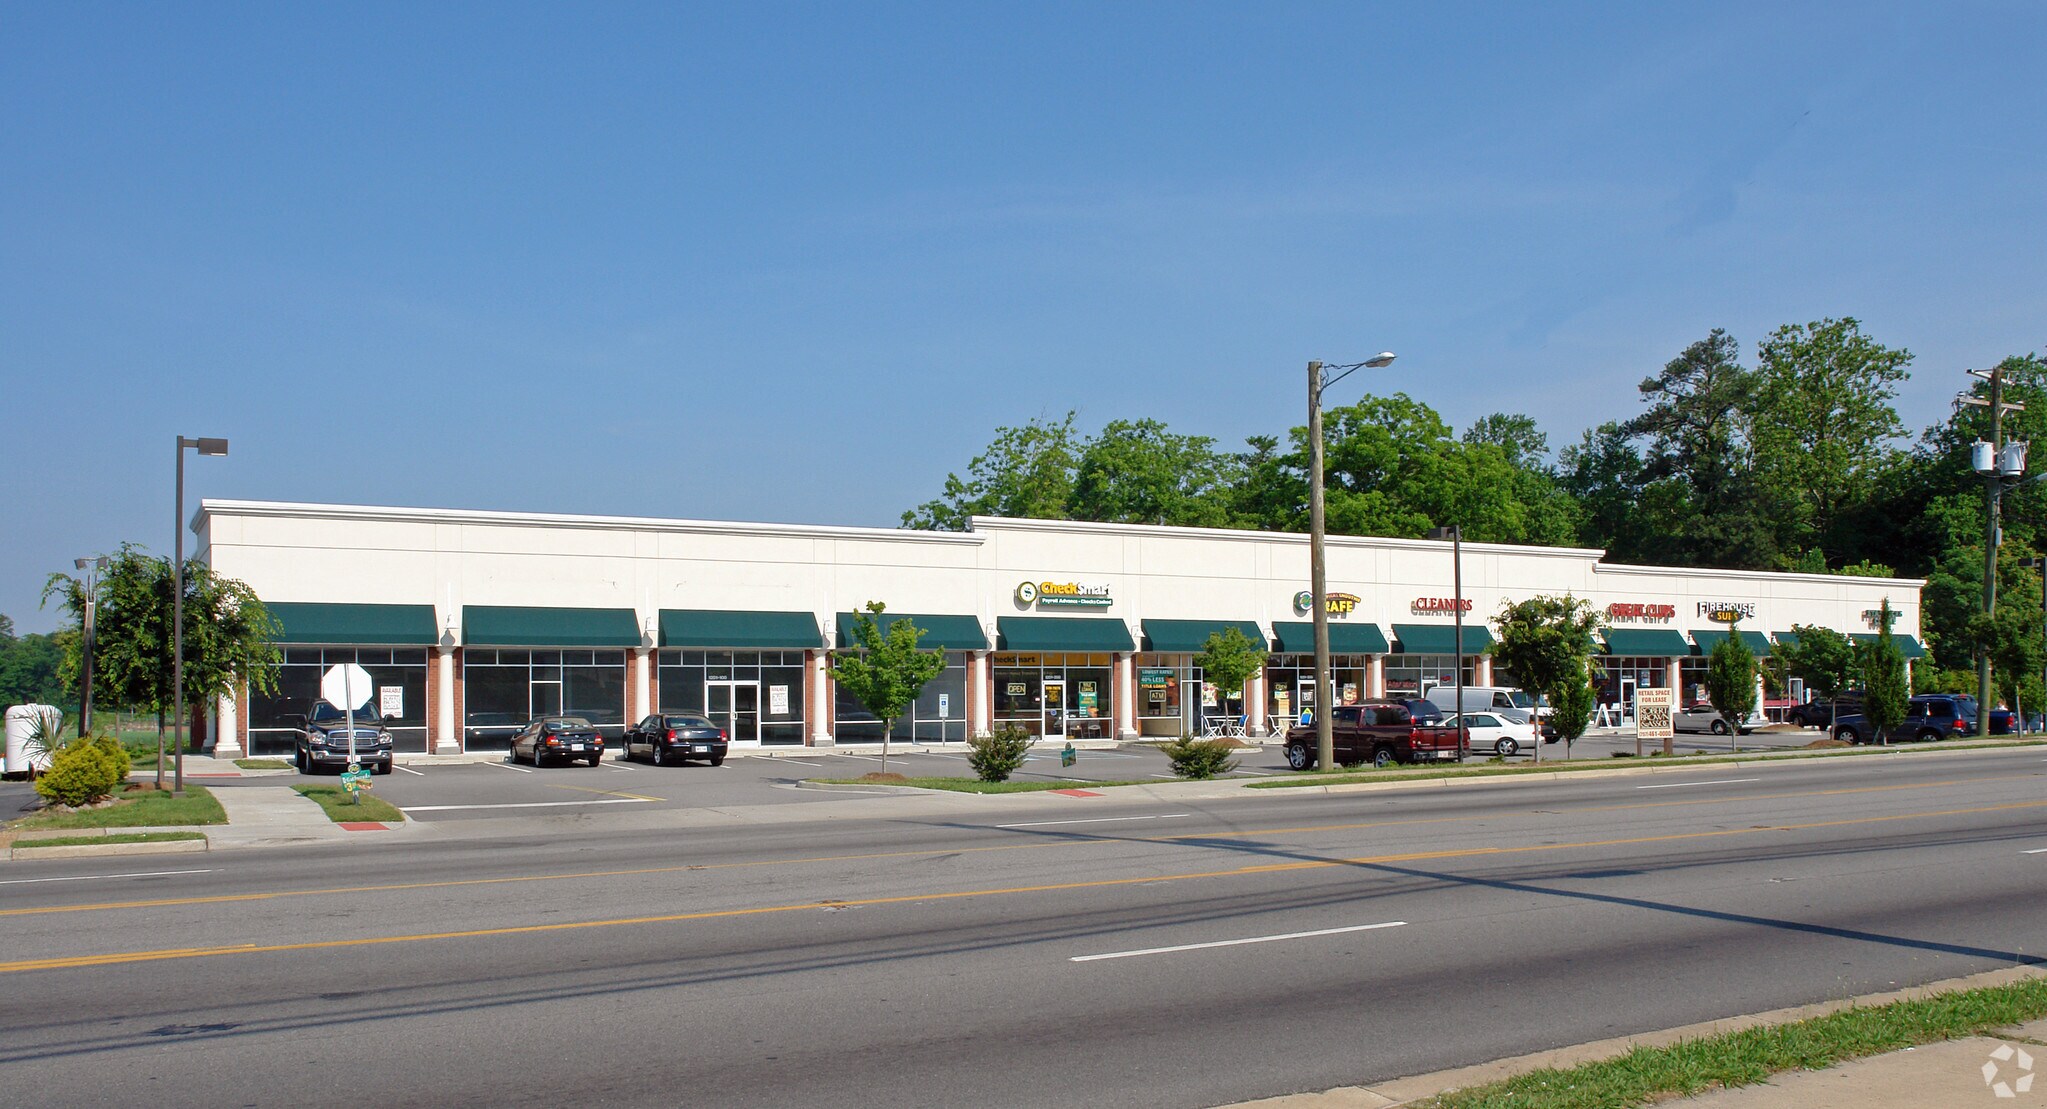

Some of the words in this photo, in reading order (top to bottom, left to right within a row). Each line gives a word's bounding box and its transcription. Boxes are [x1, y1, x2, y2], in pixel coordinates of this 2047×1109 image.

[1041, 582, 1110, 595] CheckSmart
[1609, 603, 1645, 617] GREAT
[1646, 604, 1675, 618] CLIPS
[1700, 602, 1755, 616] FIREHOUSE
[1009, 685, 1025, 693] OPEN
